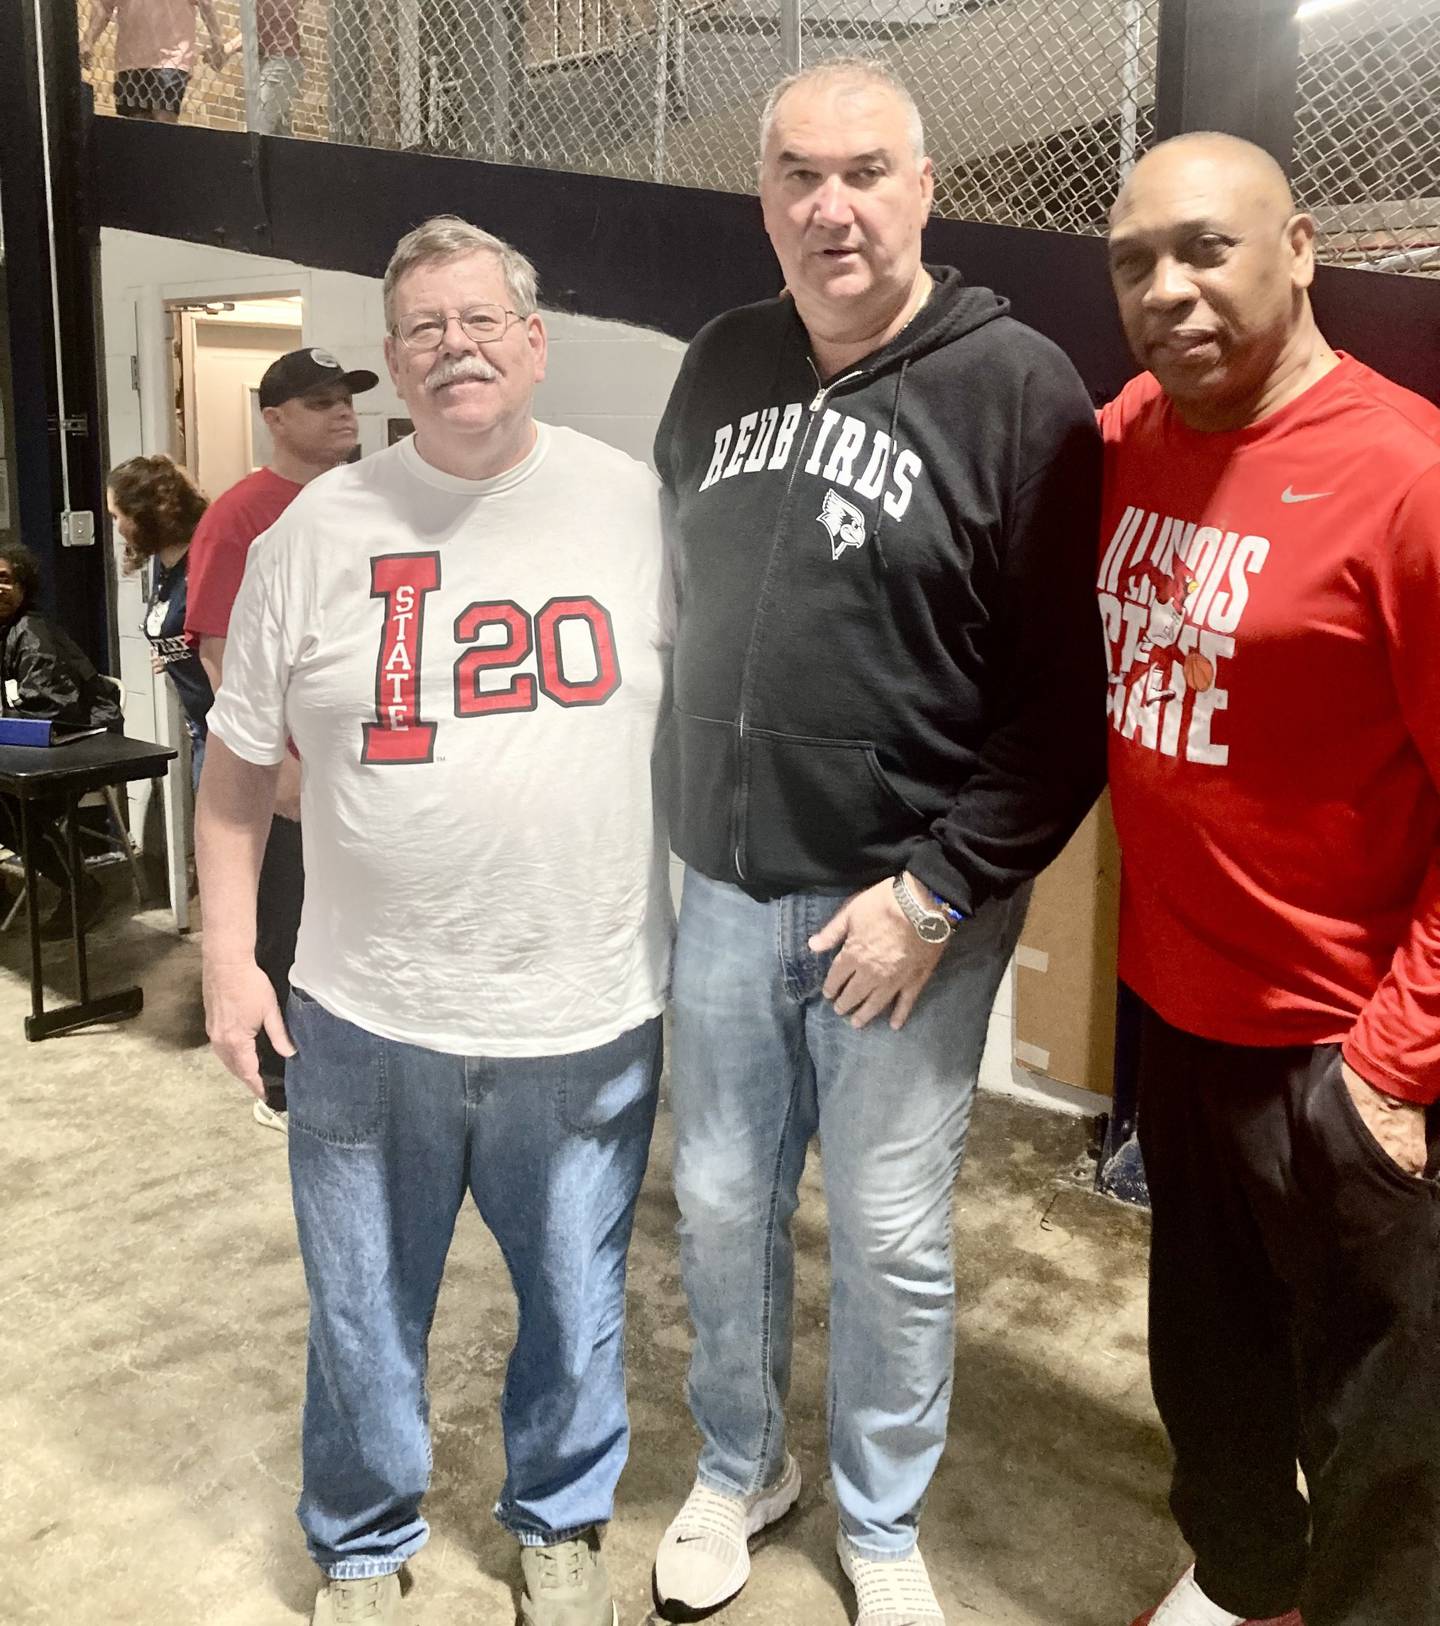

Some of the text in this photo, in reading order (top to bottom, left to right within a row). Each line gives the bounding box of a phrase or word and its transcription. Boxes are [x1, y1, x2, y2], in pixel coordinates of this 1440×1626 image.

[1096, 505, 1271, 634] ILLINOIS
[385, 585, 413, 731] STATE
[453, 595, 623, 719] 20
